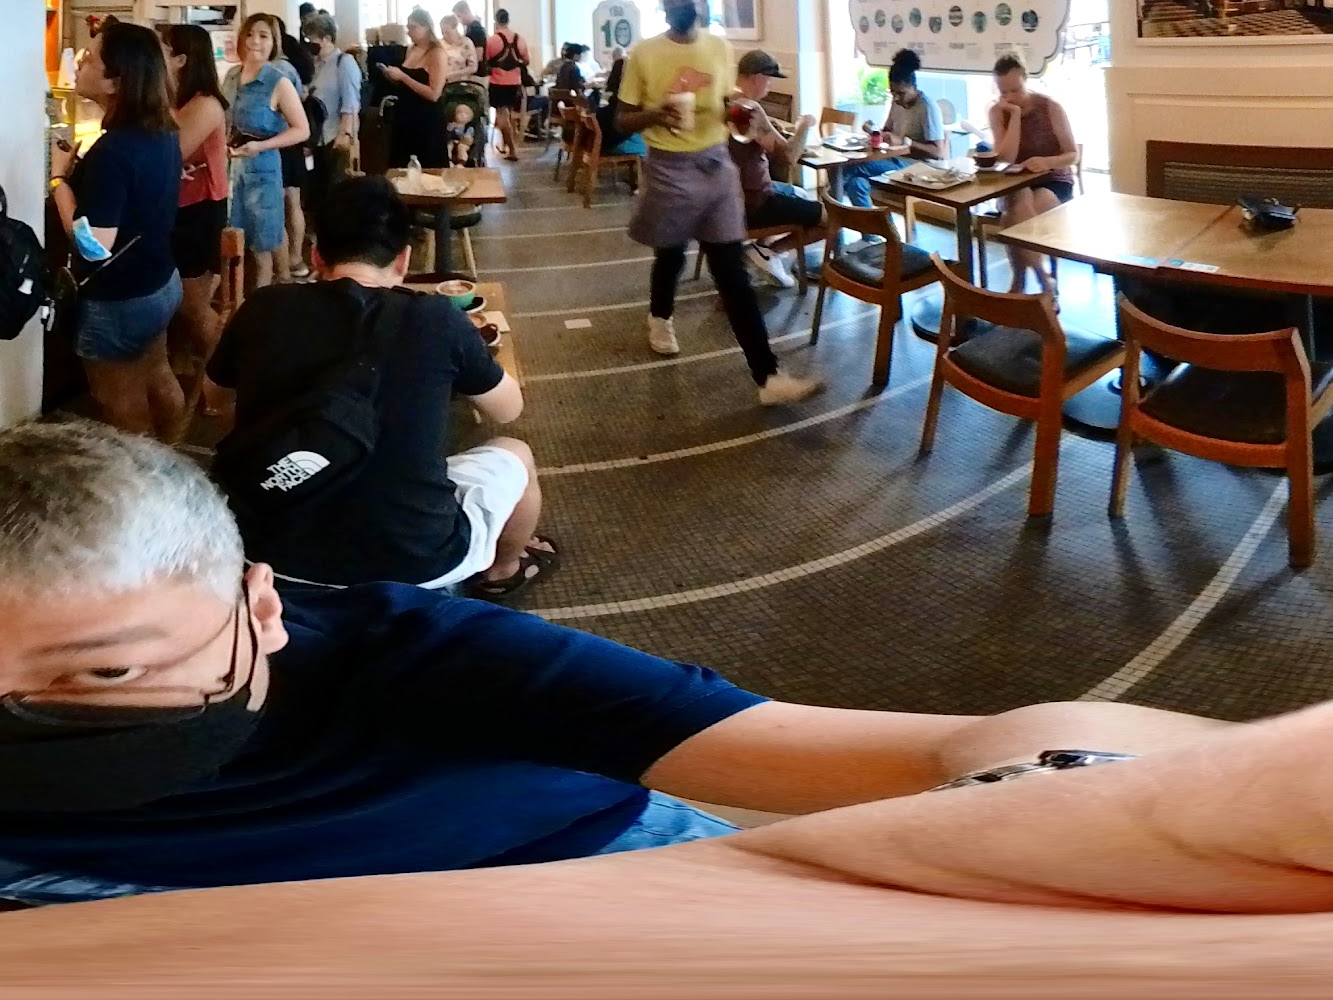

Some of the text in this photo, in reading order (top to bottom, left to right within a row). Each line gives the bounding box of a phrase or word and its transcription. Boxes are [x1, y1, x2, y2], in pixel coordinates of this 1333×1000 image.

[266, 456, 292, 475] THE
[260, 464, 303, 491] NORTH
[280, 470, 311, 492] FACE
